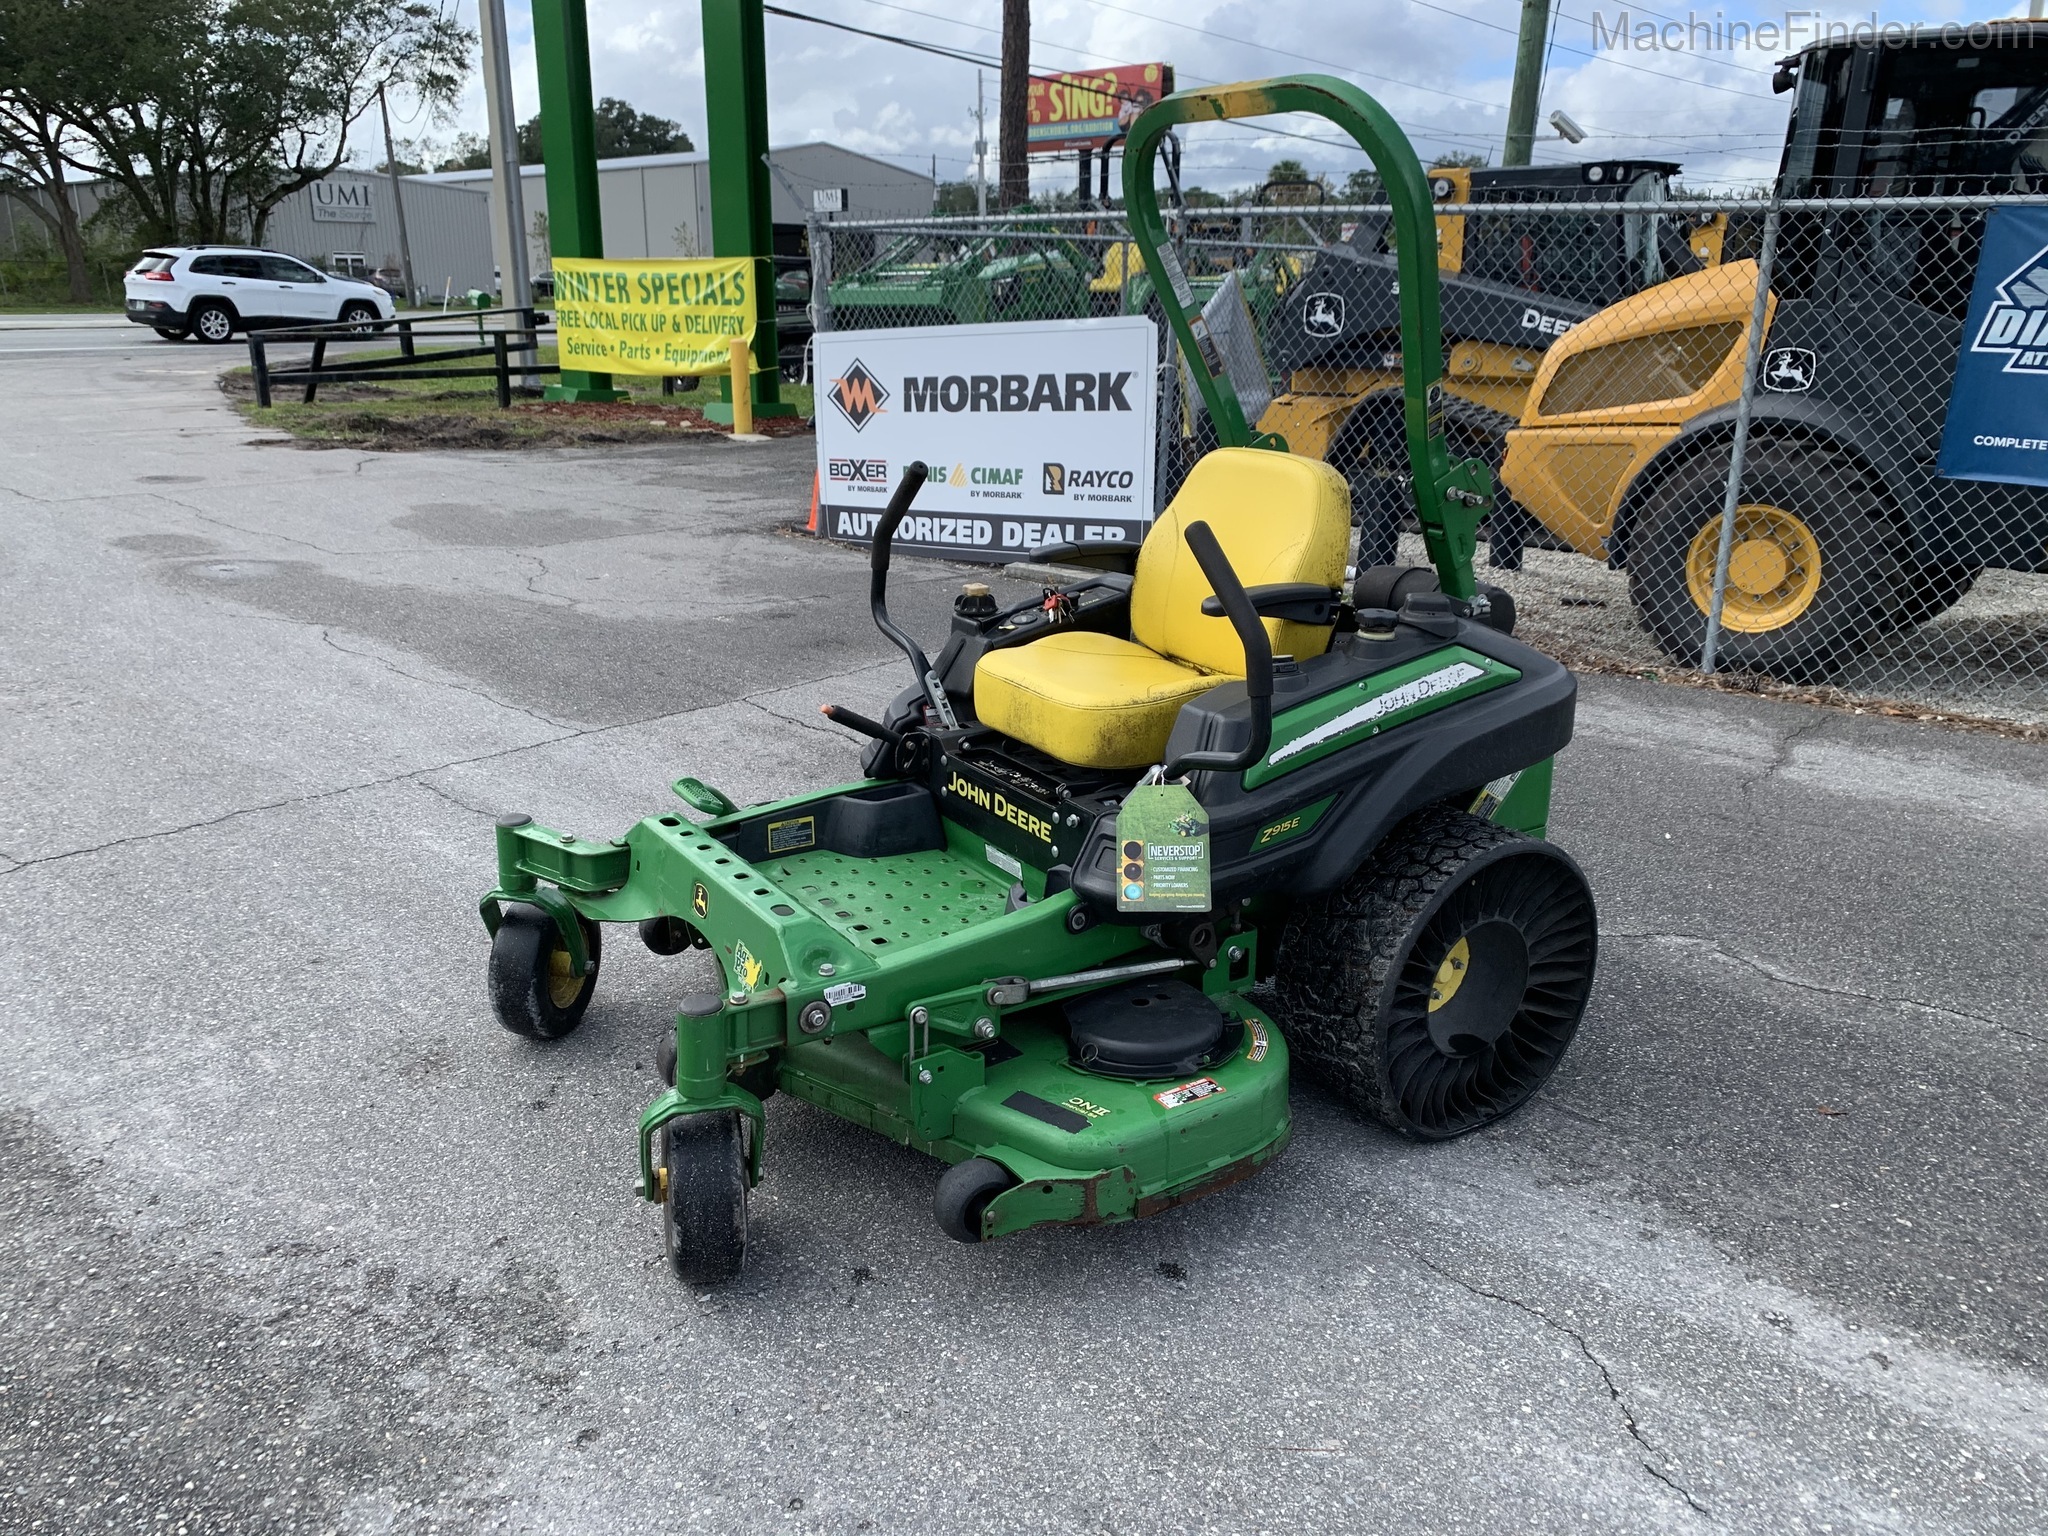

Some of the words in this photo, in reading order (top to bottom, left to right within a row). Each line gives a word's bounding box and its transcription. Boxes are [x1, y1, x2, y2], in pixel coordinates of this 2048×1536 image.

[2004, 97, 2048, 146] DEER
[315, 182, 370, 207] UMI
[317, 208, 337, 218] The
[553, 271, 631, 304] WINTER
[637, 271, 746, 307] SPECIALS
[583, 310, 619, 331] LOCAL
[621, 312, 649, 332] PICK
[651, 313, 667, 333] UP
[672, 314, 682, 334] &
[685, 314, 746, 336] DELIVERY
[1521, 307, 1579, 336] DEE
[566, 336, 608, 357] Service
[618, 339, 651, 361] Parts
[2018, 350, 2048, 367] AT
[903, 371, 1133, 413] MORBARK
[1973, 435, 2048, 451] COMPLETE
[829, 458, 887, 482] BOXER
[902, 465, 948, 484] NIS
[970, 466, 1024, 486] CIMAF
[1067, 469, 1134, 490] RAYCO
[847, 484, 856, 492] BY
[857, 485, 888, 494] MORBARK
[970, 489, 981, 498] BY
[982, 490, 1022, 500] MORBARK
[1073, 493, 1085, 502] BY
[1087, 494, 1132, 504] MORBARK
[836, 511, 993, 546] AUTORIZED
[947, 771, 991, 810] JOHN
[994, 792, 1052, 844] DEERE
[1260, 815, 1301, 845] Z915E
[1150, 845, 1201, 857] NEVERSTOP
